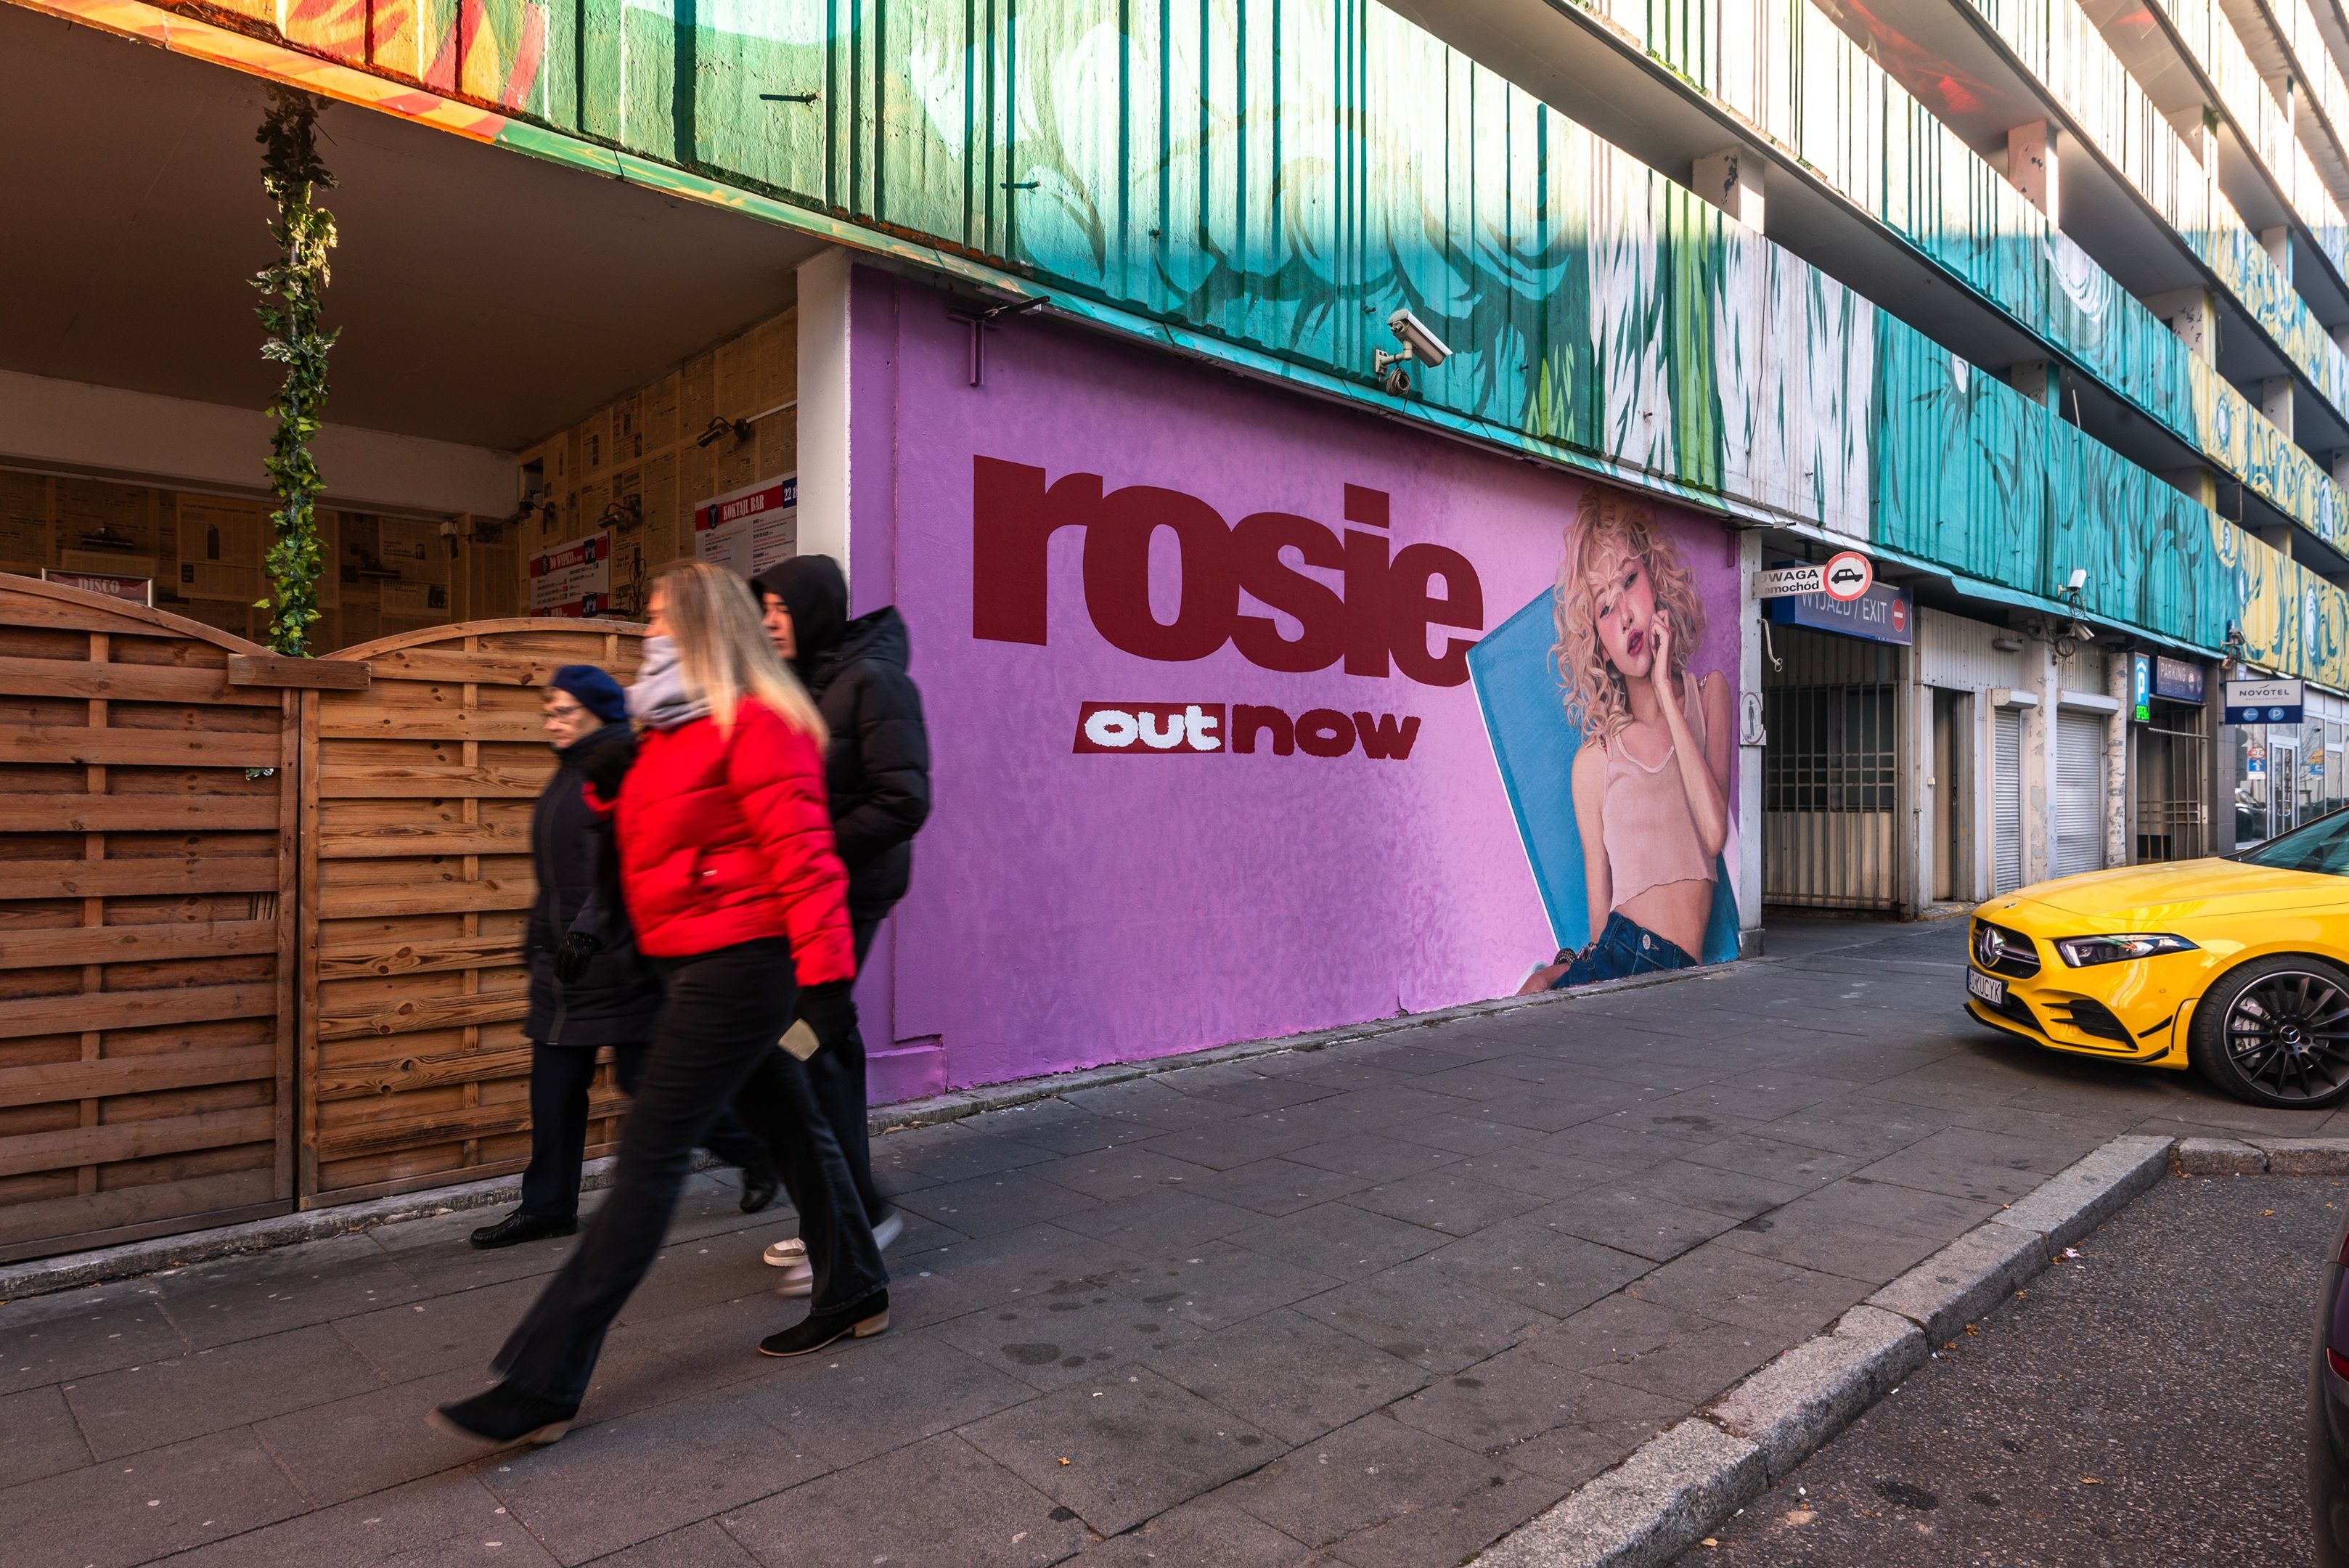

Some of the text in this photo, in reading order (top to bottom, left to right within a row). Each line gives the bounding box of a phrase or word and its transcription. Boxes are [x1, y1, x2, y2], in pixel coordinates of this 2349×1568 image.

[723, 494, 764, 520] KOKTAJL BAR
[783, 486, 791, 502] 22
[973, 454, 1484, 687] rosie
[78, 576, 120, 594] DISCO
[1863, 598, 1887, 624] EXIT
[2160, 662, 2186, 682] PARKING
[1084, 704, 1421, 759] out now
